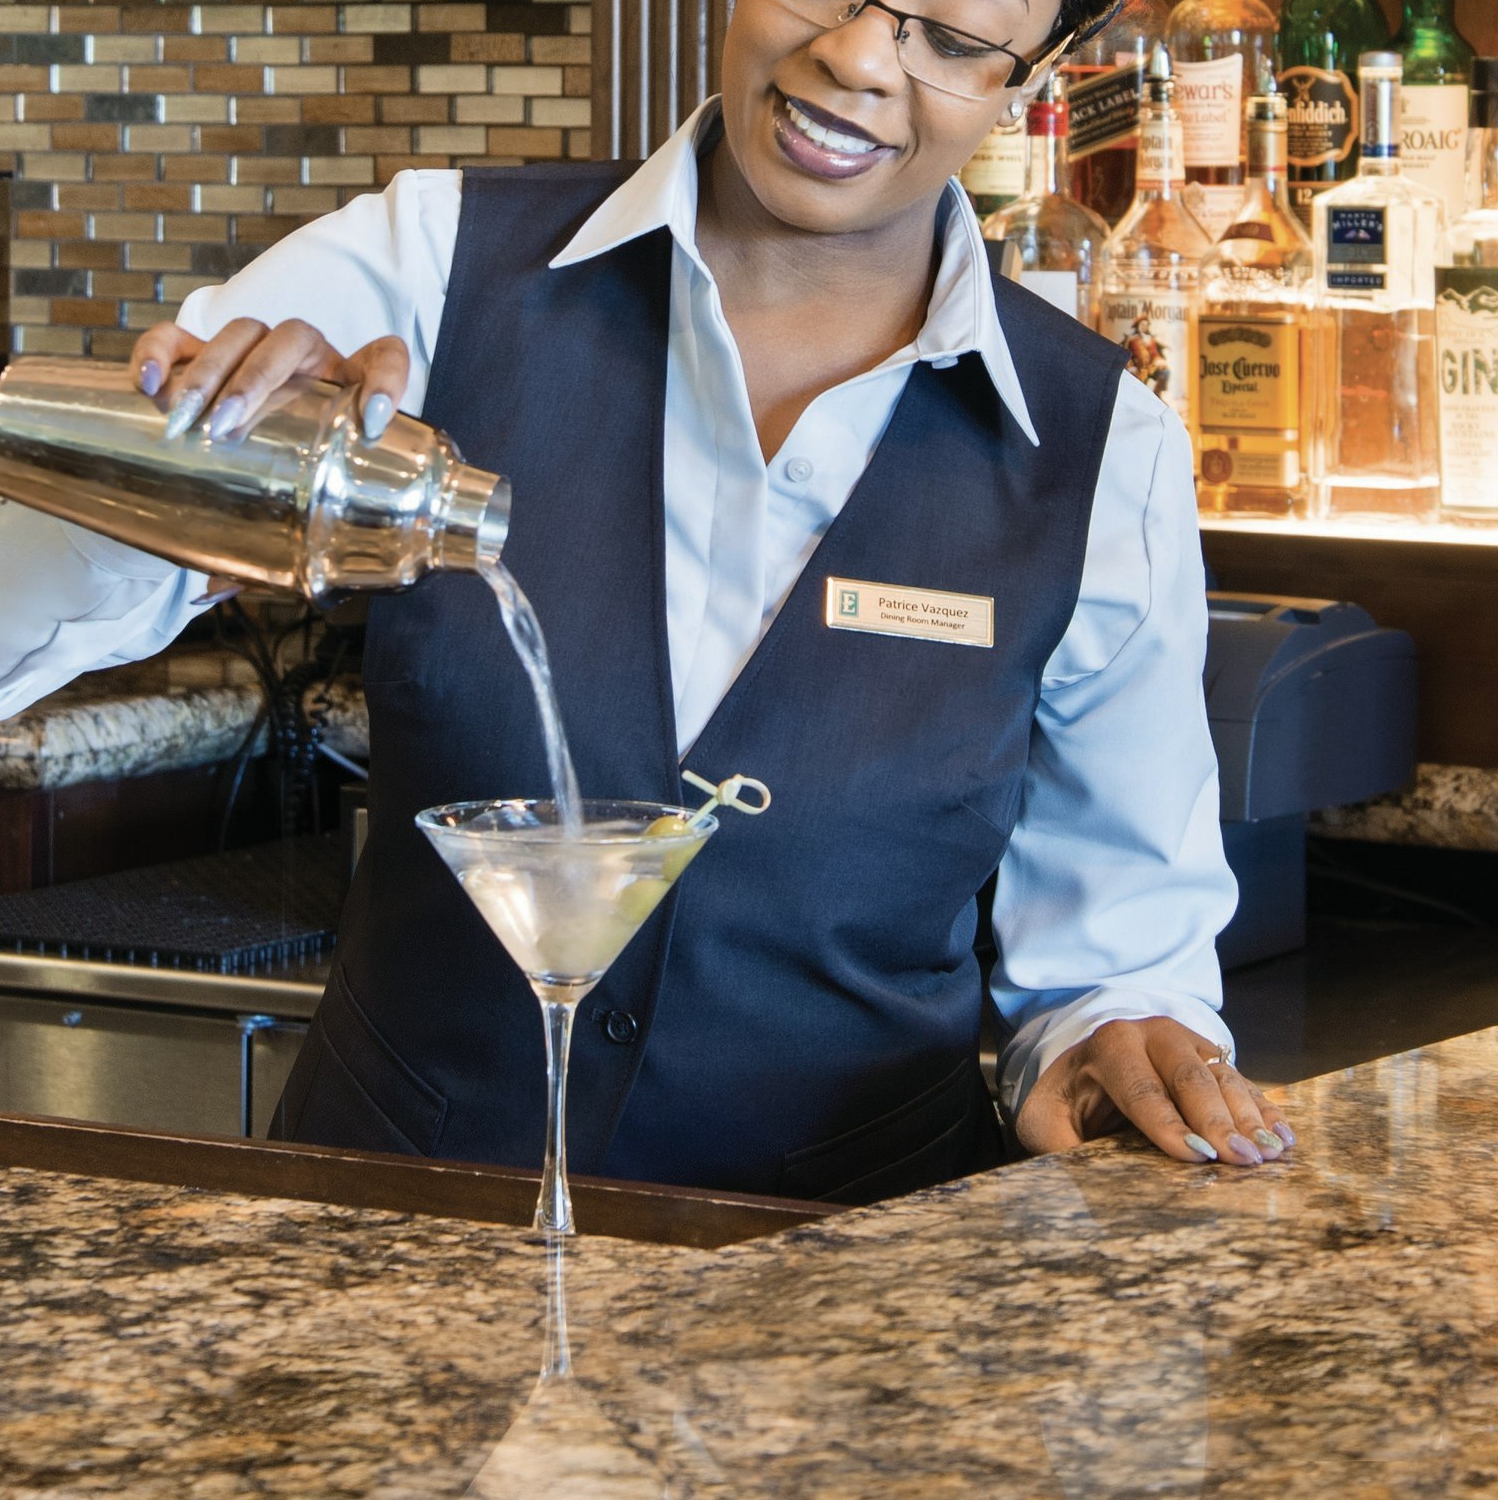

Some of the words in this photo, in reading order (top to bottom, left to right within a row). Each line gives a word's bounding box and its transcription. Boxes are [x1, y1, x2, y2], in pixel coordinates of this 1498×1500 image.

[1175, 81, 1233, 100] ewar's
[1071, 103, 1097, 121] ACK
[1287, 100, 1346, 124] nfiddich
[1400, 129, 1459, 149] ROAIG
[1297, 187, 1313, 204] 12
[1333, 276, 1383, 285] IMPORTED
[1106, 299, 1138, 322] ptain
[1233, 356, 1280, 380] Cuervo
[879, 597, 918, 612] Patrice
[920, 603, 969, 620] Vazquez
[880, 612, 905, 624] Dining
[907, 615, 929, 625] Room
[931, 617, 965, 630] Manager
